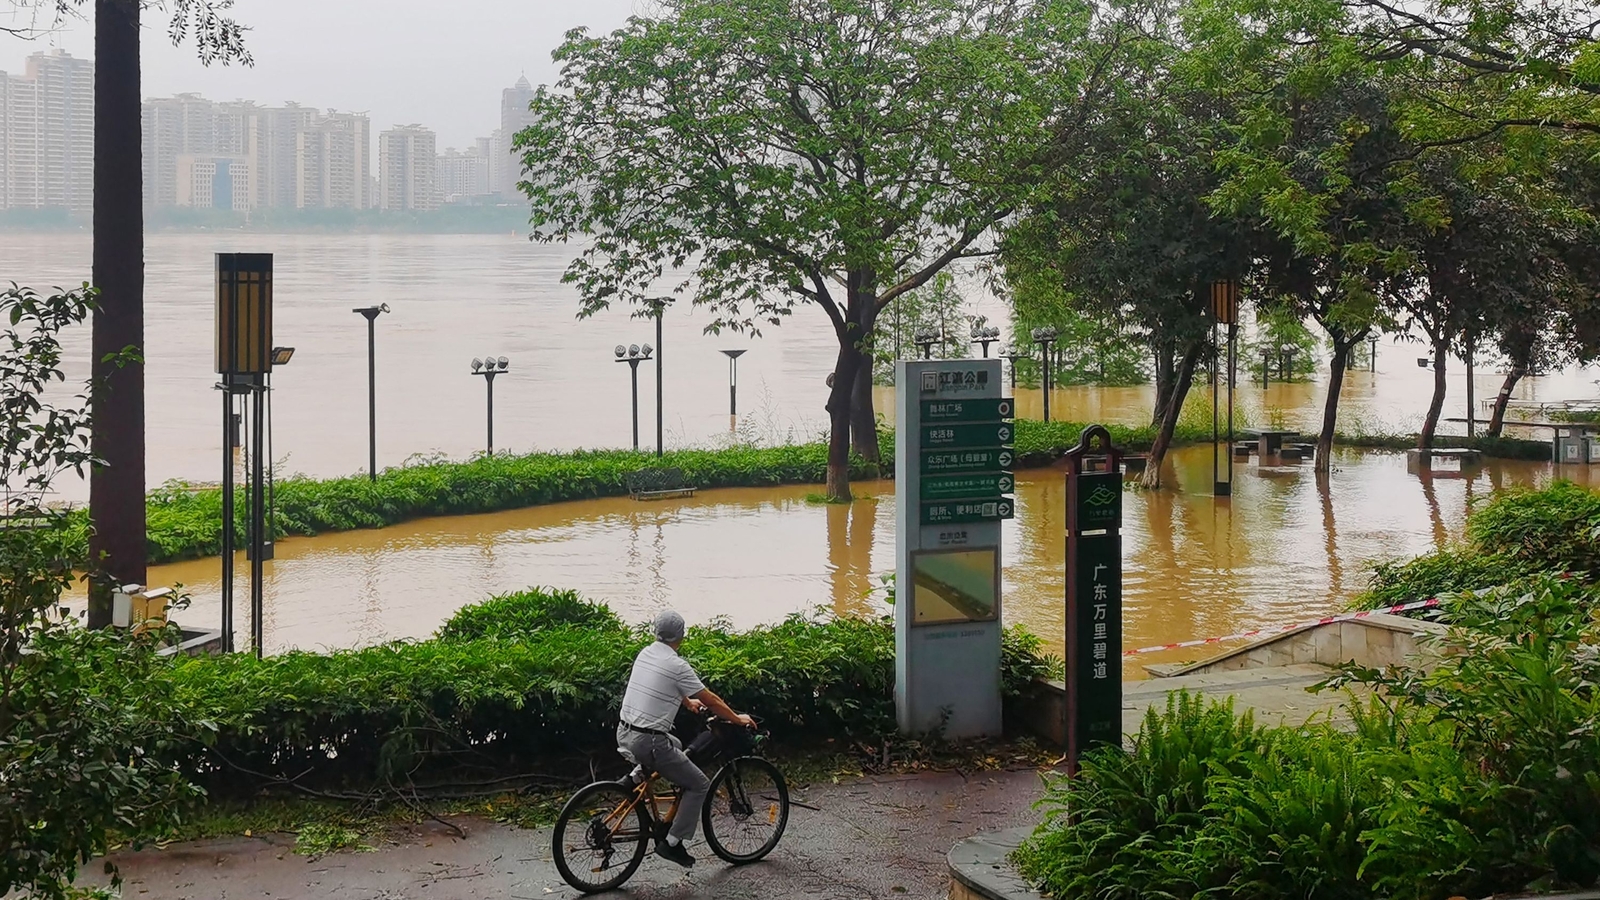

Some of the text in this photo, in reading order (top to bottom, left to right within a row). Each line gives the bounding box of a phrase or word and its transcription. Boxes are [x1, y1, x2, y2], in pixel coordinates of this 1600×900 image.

[930, 429, 954, 438] 快活林
[1093, 563, 1107, 679] 广东万里碧道
